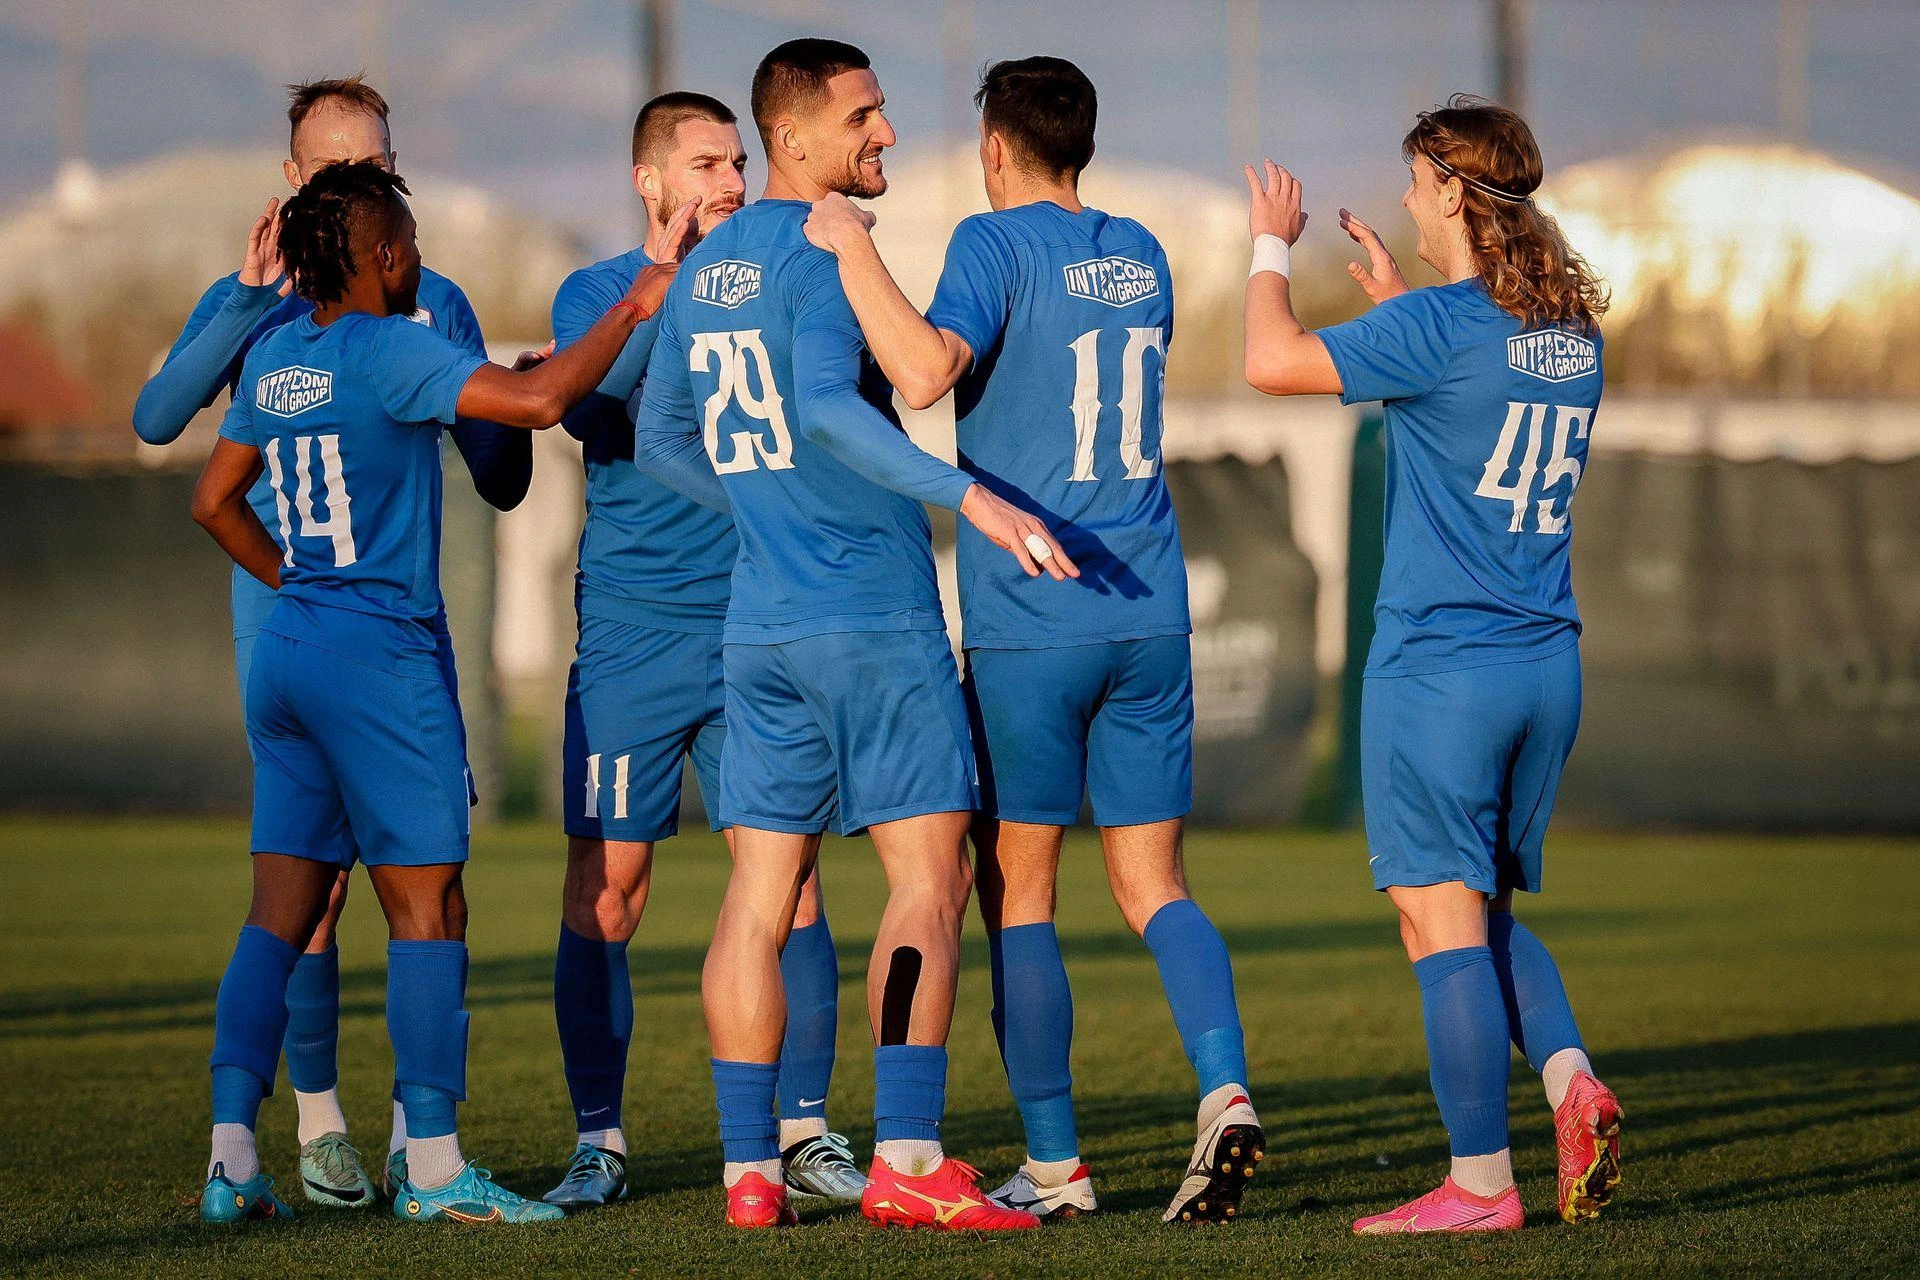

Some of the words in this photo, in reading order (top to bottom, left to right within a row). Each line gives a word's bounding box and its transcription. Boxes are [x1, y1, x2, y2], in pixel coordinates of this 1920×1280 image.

[1117, 280, 1156, 302] GROUP
[1511, 334, 1594, 377] INTERCOM
[1555, 356, 1595, 378] GROUP
[257, 370, 328, 412] INTERCOM
[289, 387, 328, 412] GROUP
[689, 328, 796, 476] 29
[1065, 327, 1168, 482] 10
[1473, 401, 1593, 535] 45
[265, 434, 357, 567] 14
[584, 753, 631, 819] 11
